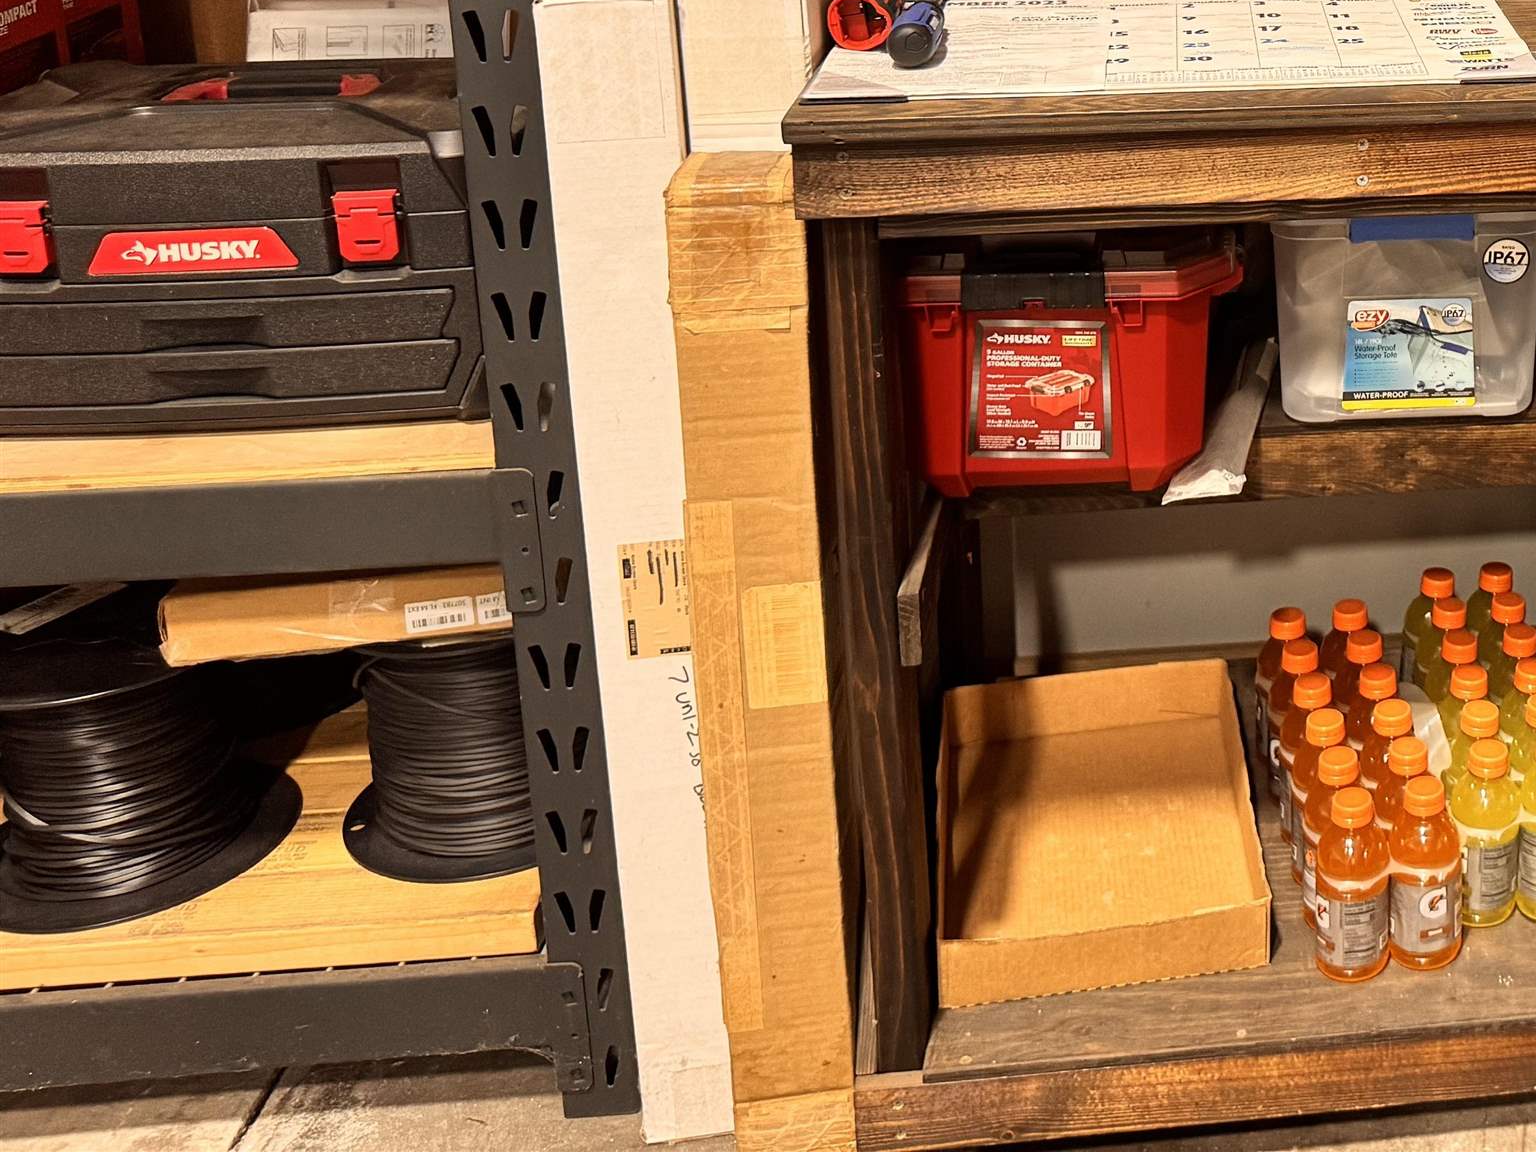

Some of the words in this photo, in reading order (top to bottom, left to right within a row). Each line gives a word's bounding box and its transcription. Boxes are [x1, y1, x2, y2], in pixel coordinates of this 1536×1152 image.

[0, 0, 38, 26] OMPACT
[157, 239, 261, 263] HUSKY
[1488, 250, 1526, 267] IP67
[1356, 309, 1387, 323] ezy
[1004, 334, 1051, 344] HUSKY
[1354, 352, 1382, 360] Storage
[1383, 351, 1398, 359] Tote
[1353, 391, 1409, 400] WATER-PROOF
